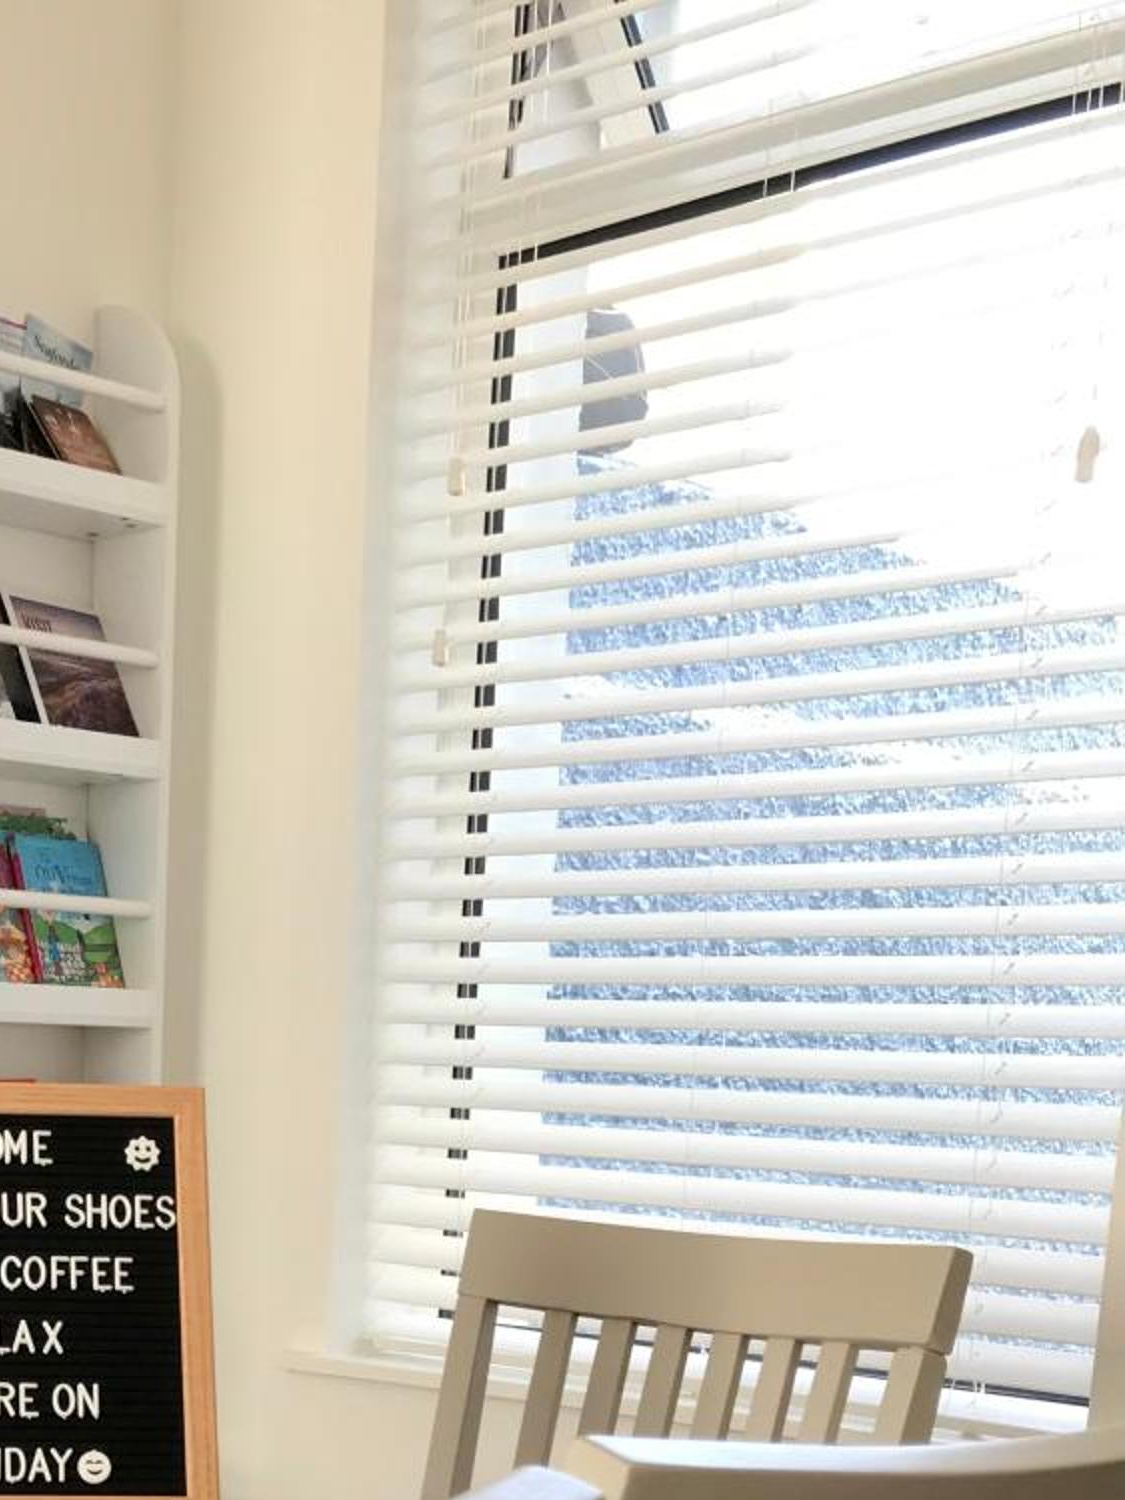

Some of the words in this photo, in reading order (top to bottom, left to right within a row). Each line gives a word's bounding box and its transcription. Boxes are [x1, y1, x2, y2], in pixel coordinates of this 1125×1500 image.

[65, 1194, 176, 1231] SHOES
[0, 1256, 133, 1294] COFFEE
[52, 1383, 99, 1419] ON
